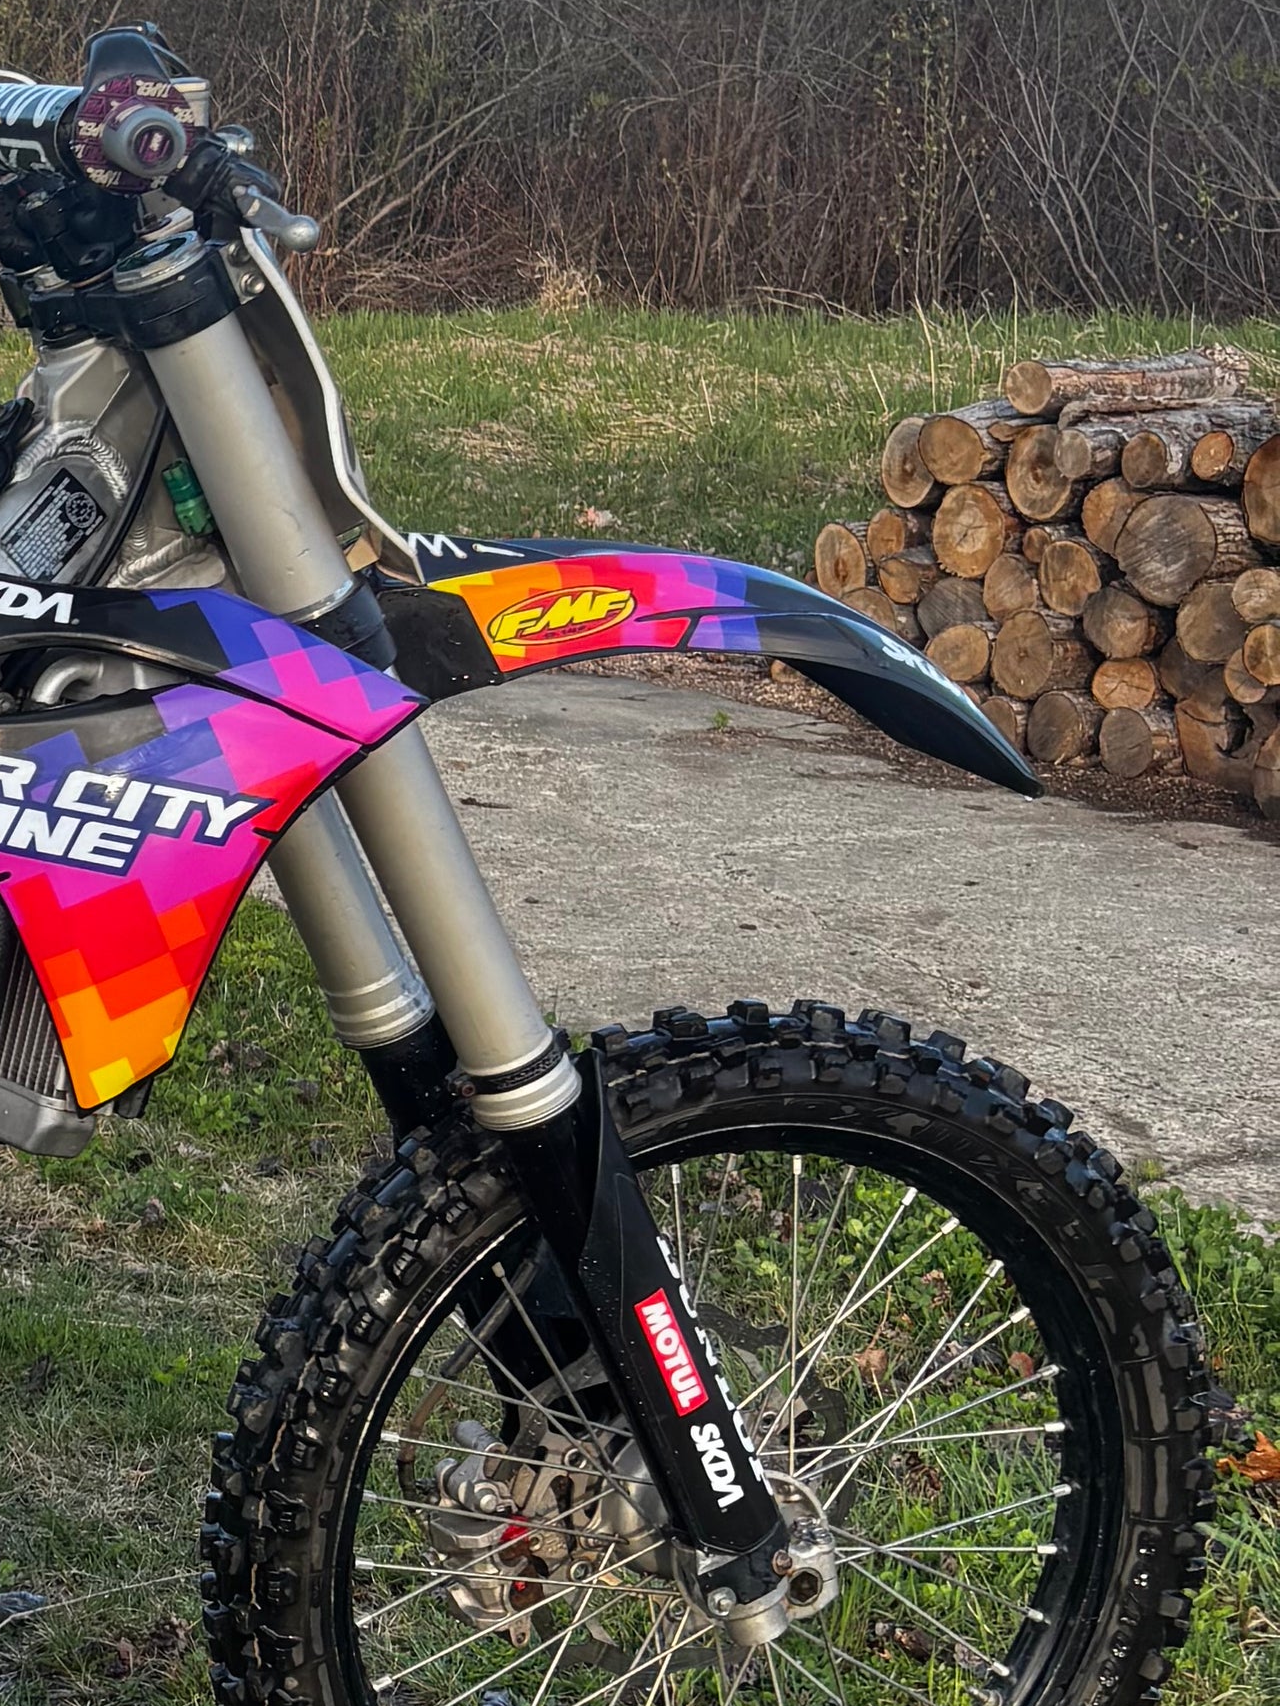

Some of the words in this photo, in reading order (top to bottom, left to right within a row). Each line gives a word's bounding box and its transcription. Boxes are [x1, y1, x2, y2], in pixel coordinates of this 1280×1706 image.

[494, 590, 631, 643] FMF
[52, 770, 260, 839] CITY
[642, 1301, 705, 1409] MOTUL
